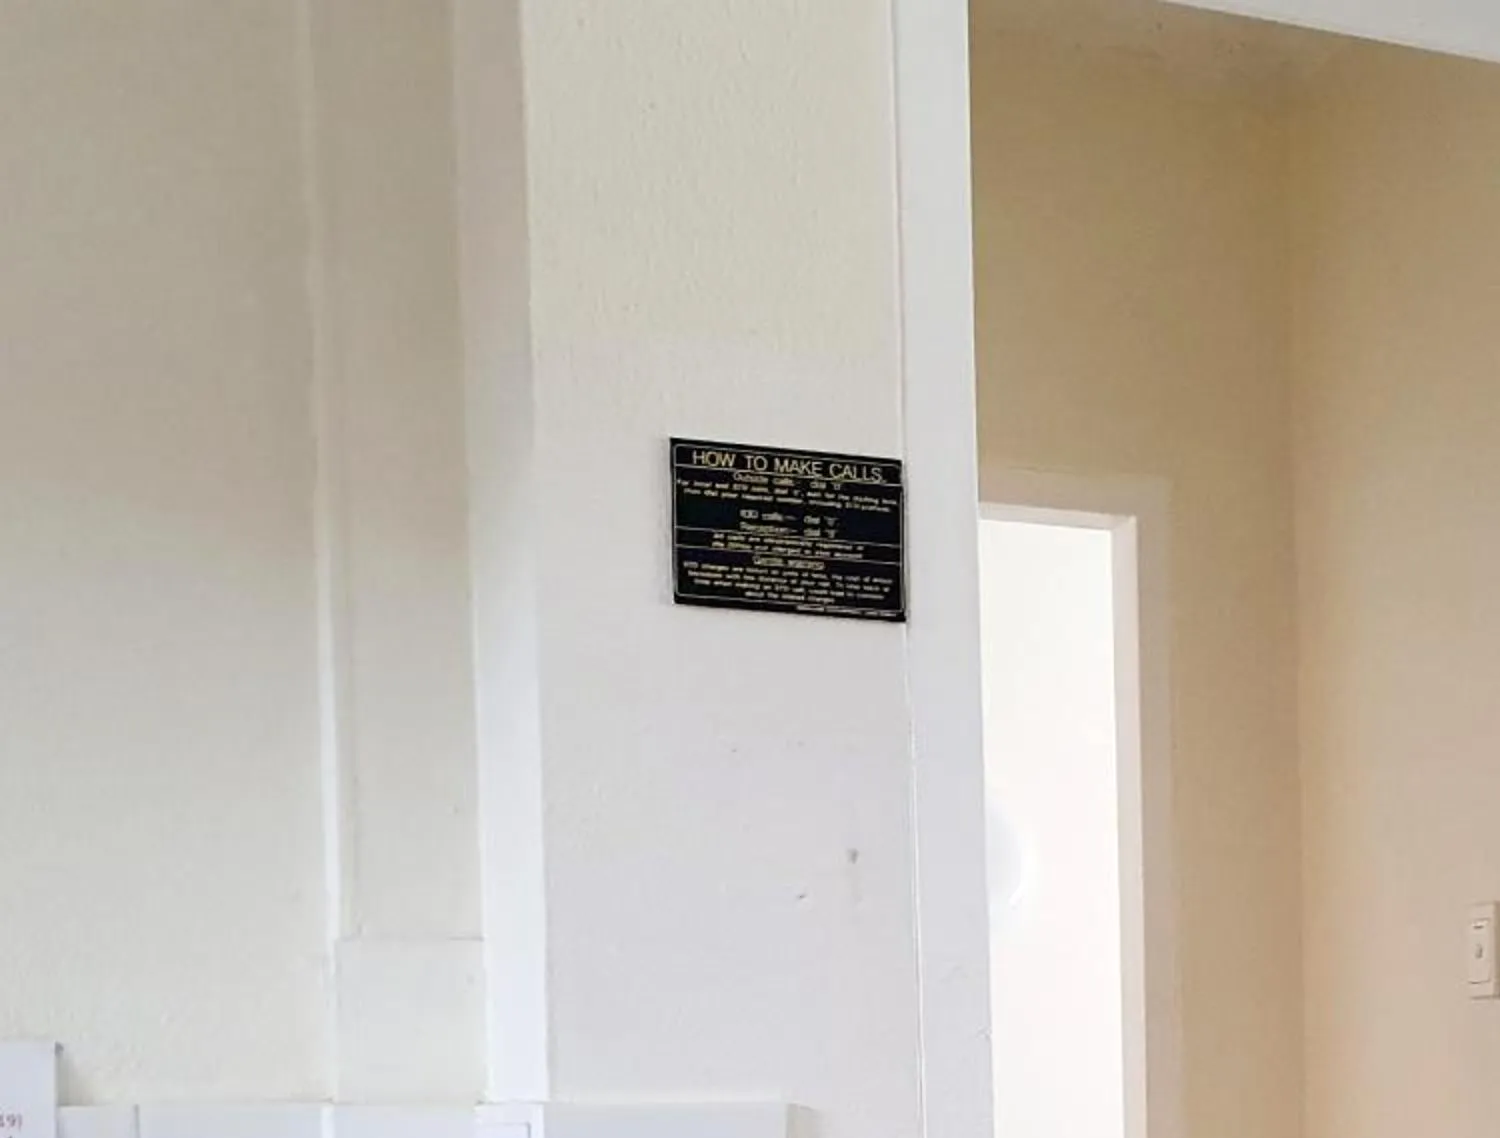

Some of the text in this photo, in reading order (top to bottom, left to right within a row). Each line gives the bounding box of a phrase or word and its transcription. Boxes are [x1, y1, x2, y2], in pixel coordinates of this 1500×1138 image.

[692, 450, 736, 468] HOW
[744, 455, 769, 472] TO
[774, 457, 824, 478] MAKE
